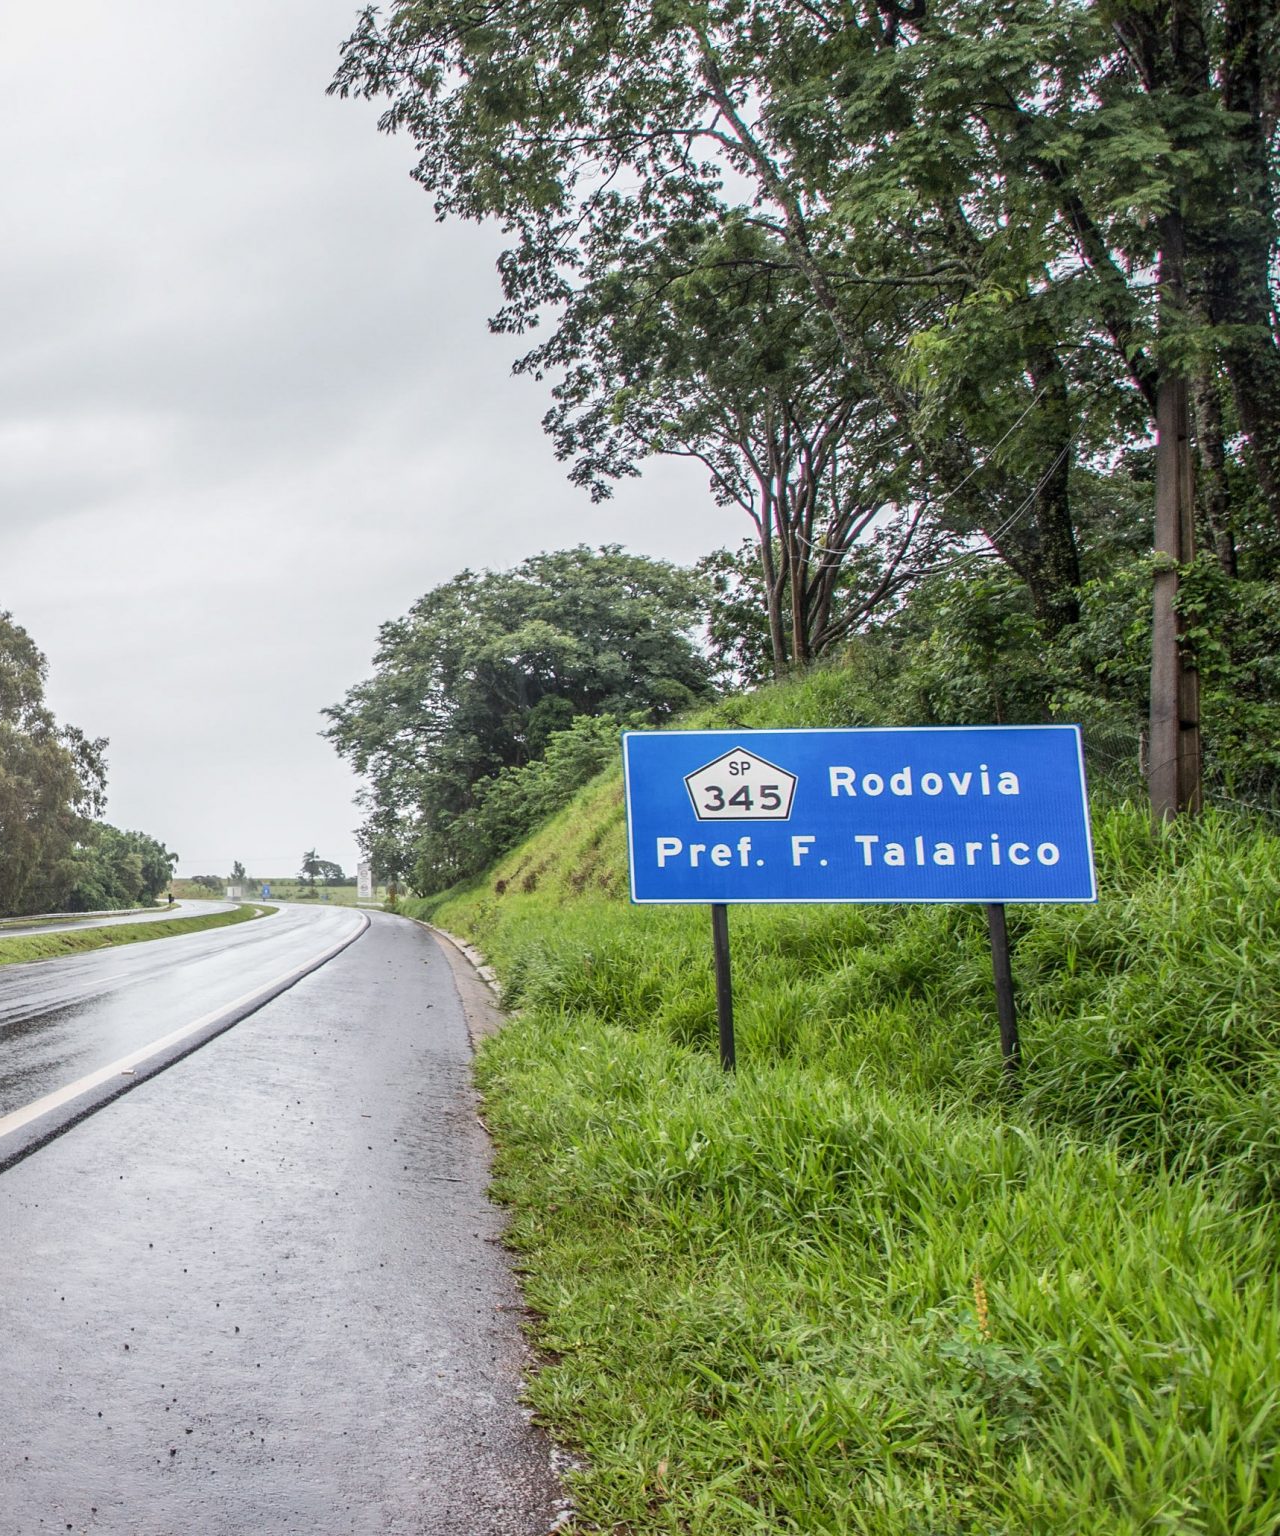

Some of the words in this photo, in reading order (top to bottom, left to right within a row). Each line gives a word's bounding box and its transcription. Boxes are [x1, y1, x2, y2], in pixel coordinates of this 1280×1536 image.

[728, 761, 751, 776] SP
[829, 764, 1020, 797] Rodovia
[704, 785, 781, 811] 345
[657, 836, 765, 867] Pref.
[792, 836, 828, 867] F.
[855, 833, 1061, 867] Talarico
